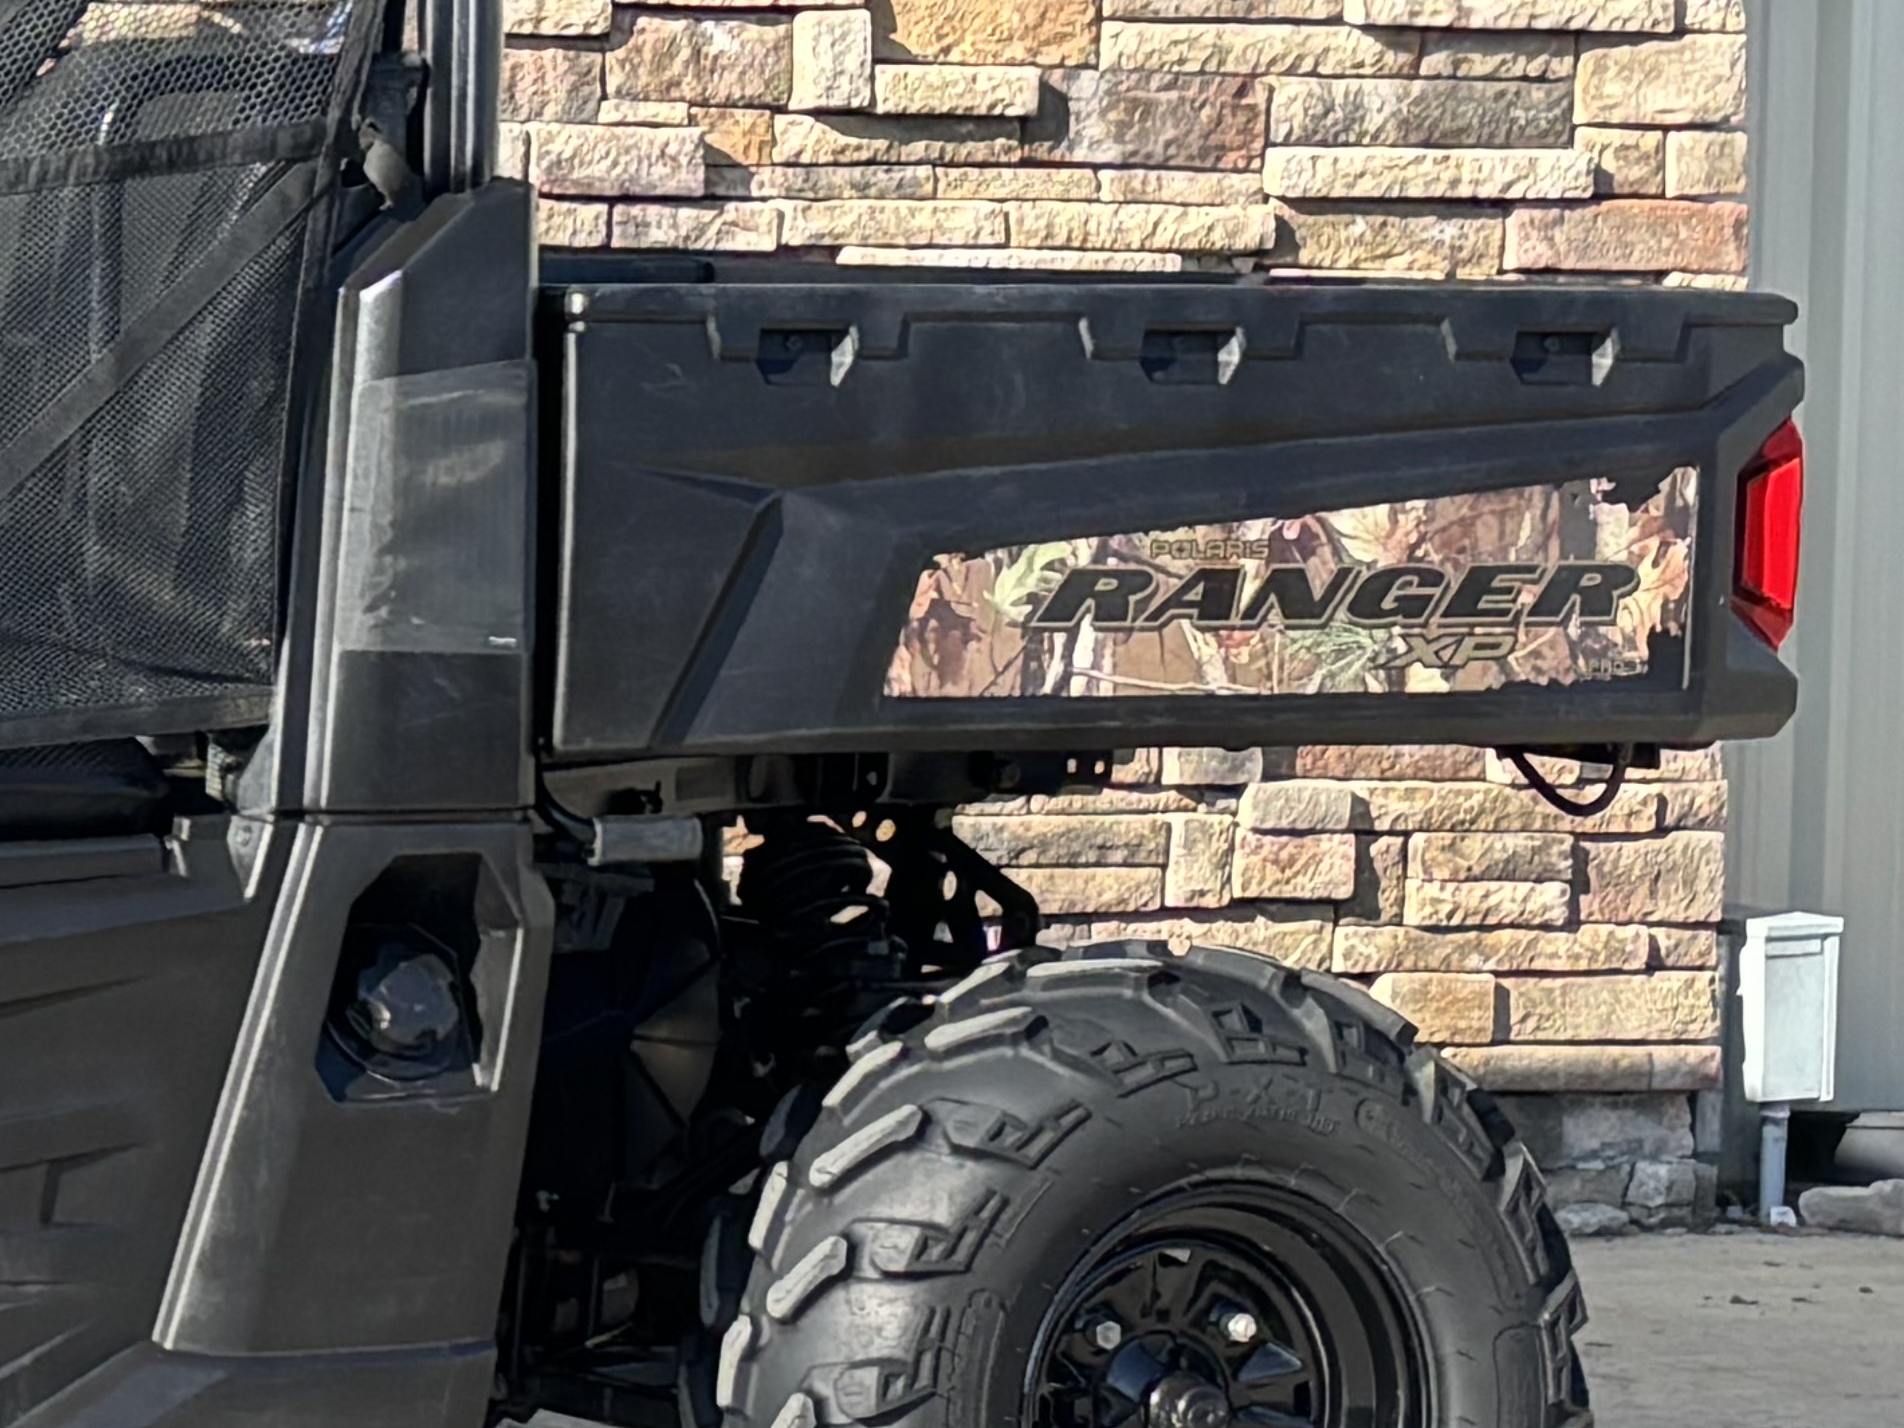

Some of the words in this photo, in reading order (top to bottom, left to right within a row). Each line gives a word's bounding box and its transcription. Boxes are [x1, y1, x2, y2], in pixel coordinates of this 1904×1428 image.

[1151, 538, 1271, 561] POLARIS
[1028, 562, 1641, 632] RANGER
[1379, 630, 1525, 669] XP
